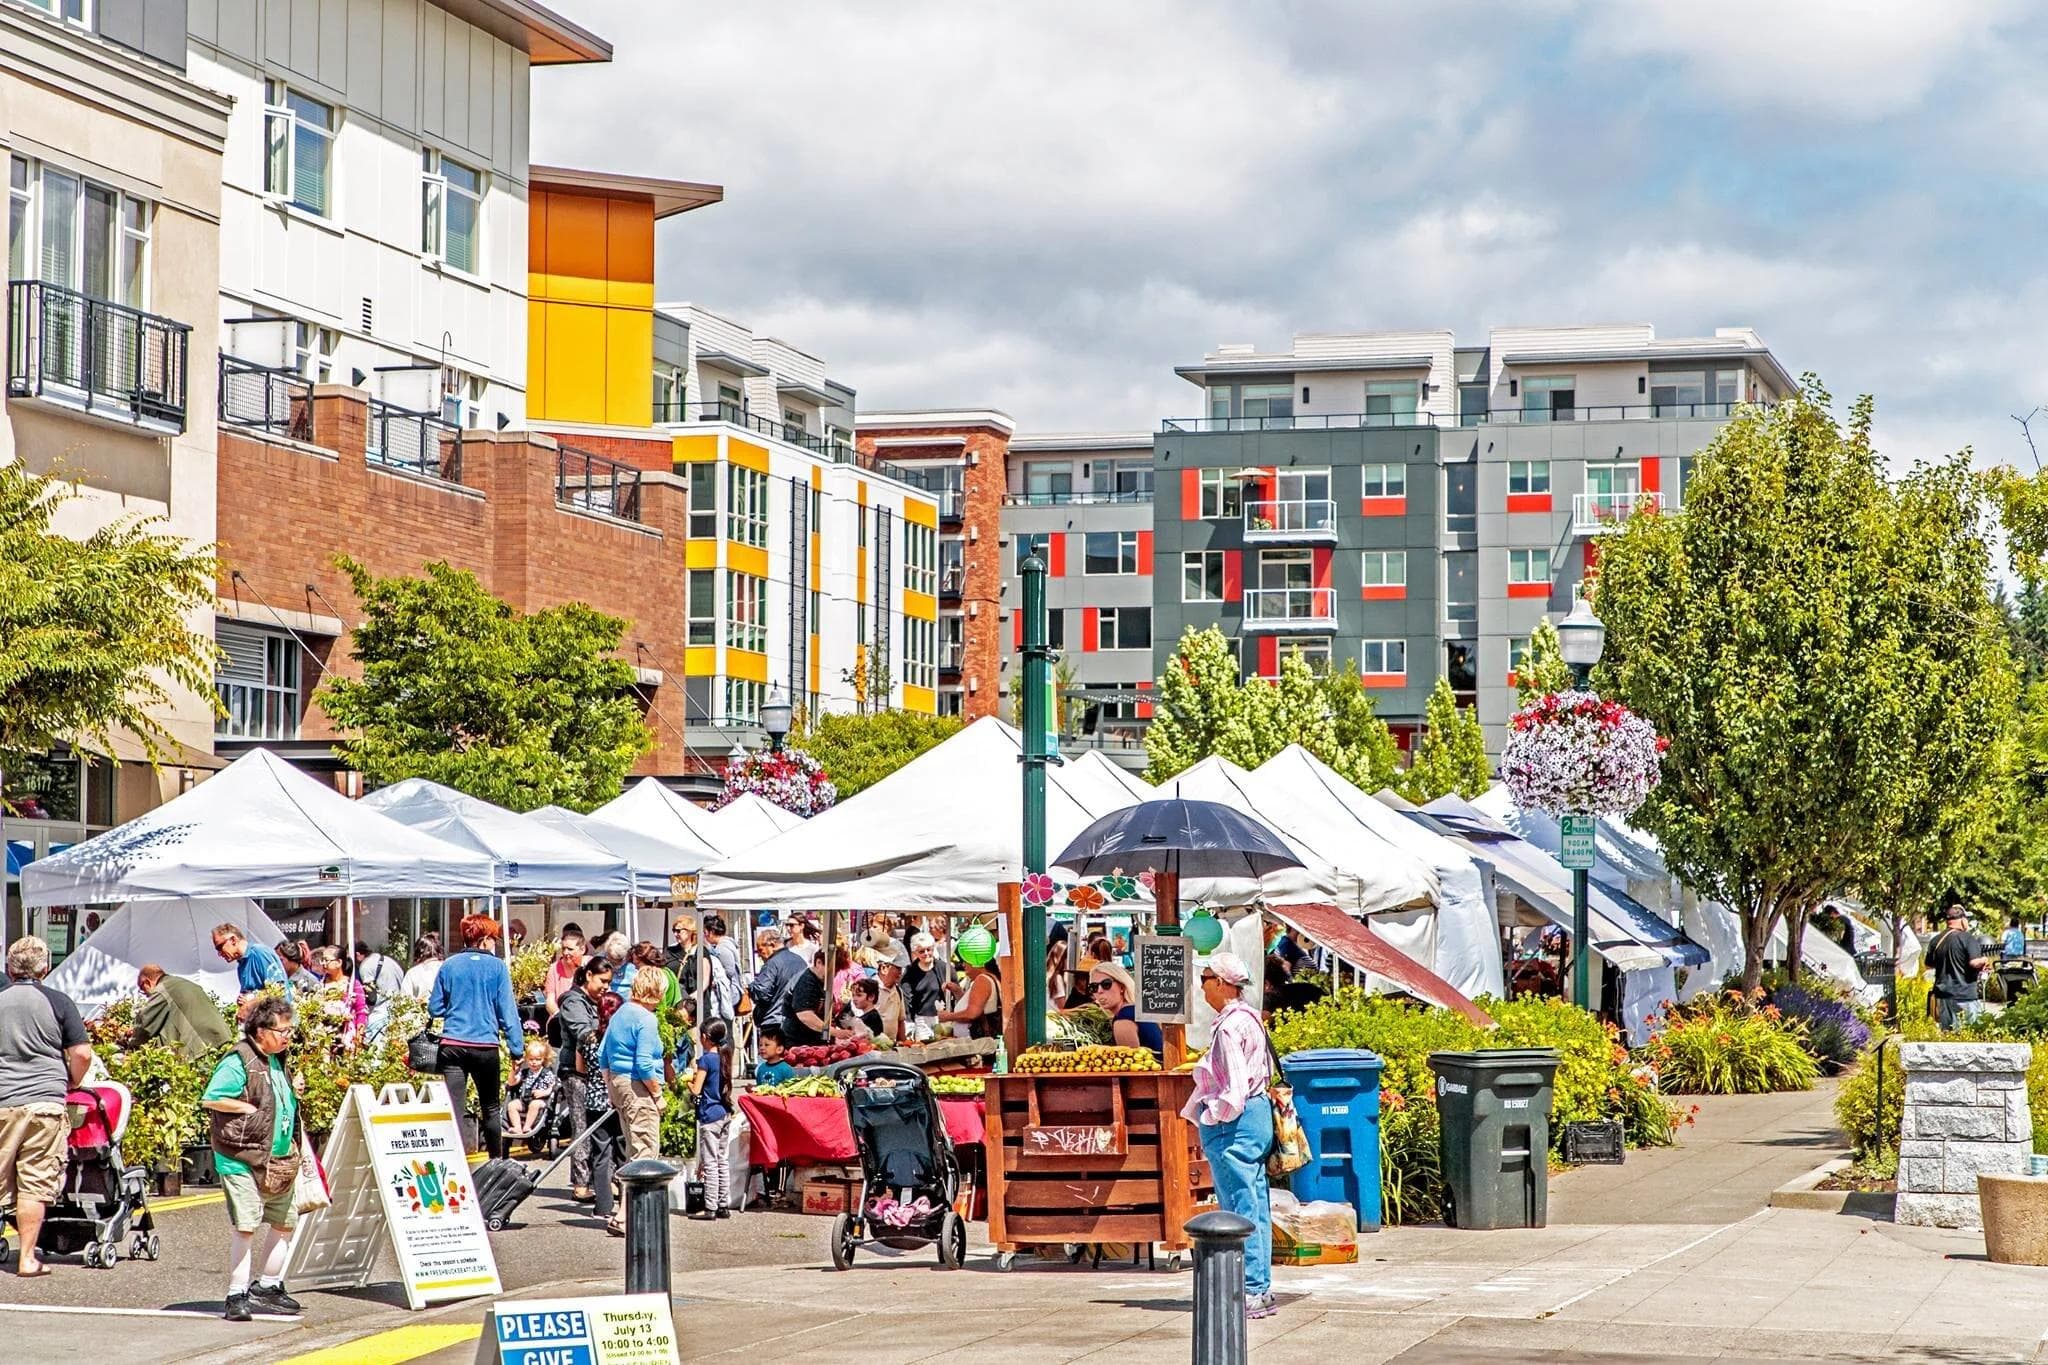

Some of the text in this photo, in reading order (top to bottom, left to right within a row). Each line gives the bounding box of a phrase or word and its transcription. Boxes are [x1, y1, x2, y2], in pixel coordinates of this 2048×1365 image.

[1563, 820, 1571, 833] 2
[298, 920, 303, 932] &
[305, 918, 325, 932] Nuts!
[1144, 944, 1183, 956] Fresh Fruit
[1148, 998, 1177, 1010] Burien
[1446, 1082, 1468, 1094] GARBAGE
[401, 1128, 428, 1139] WHAT DO
[391, 1138, 445, 1150] FRESH BUCKS BUY?
[501, 1312, 585, 1339] PLEASE
[614, 1323, 652, 1336] July 13
[601, 1335, 669, 1350] 10:00 to 4:00
